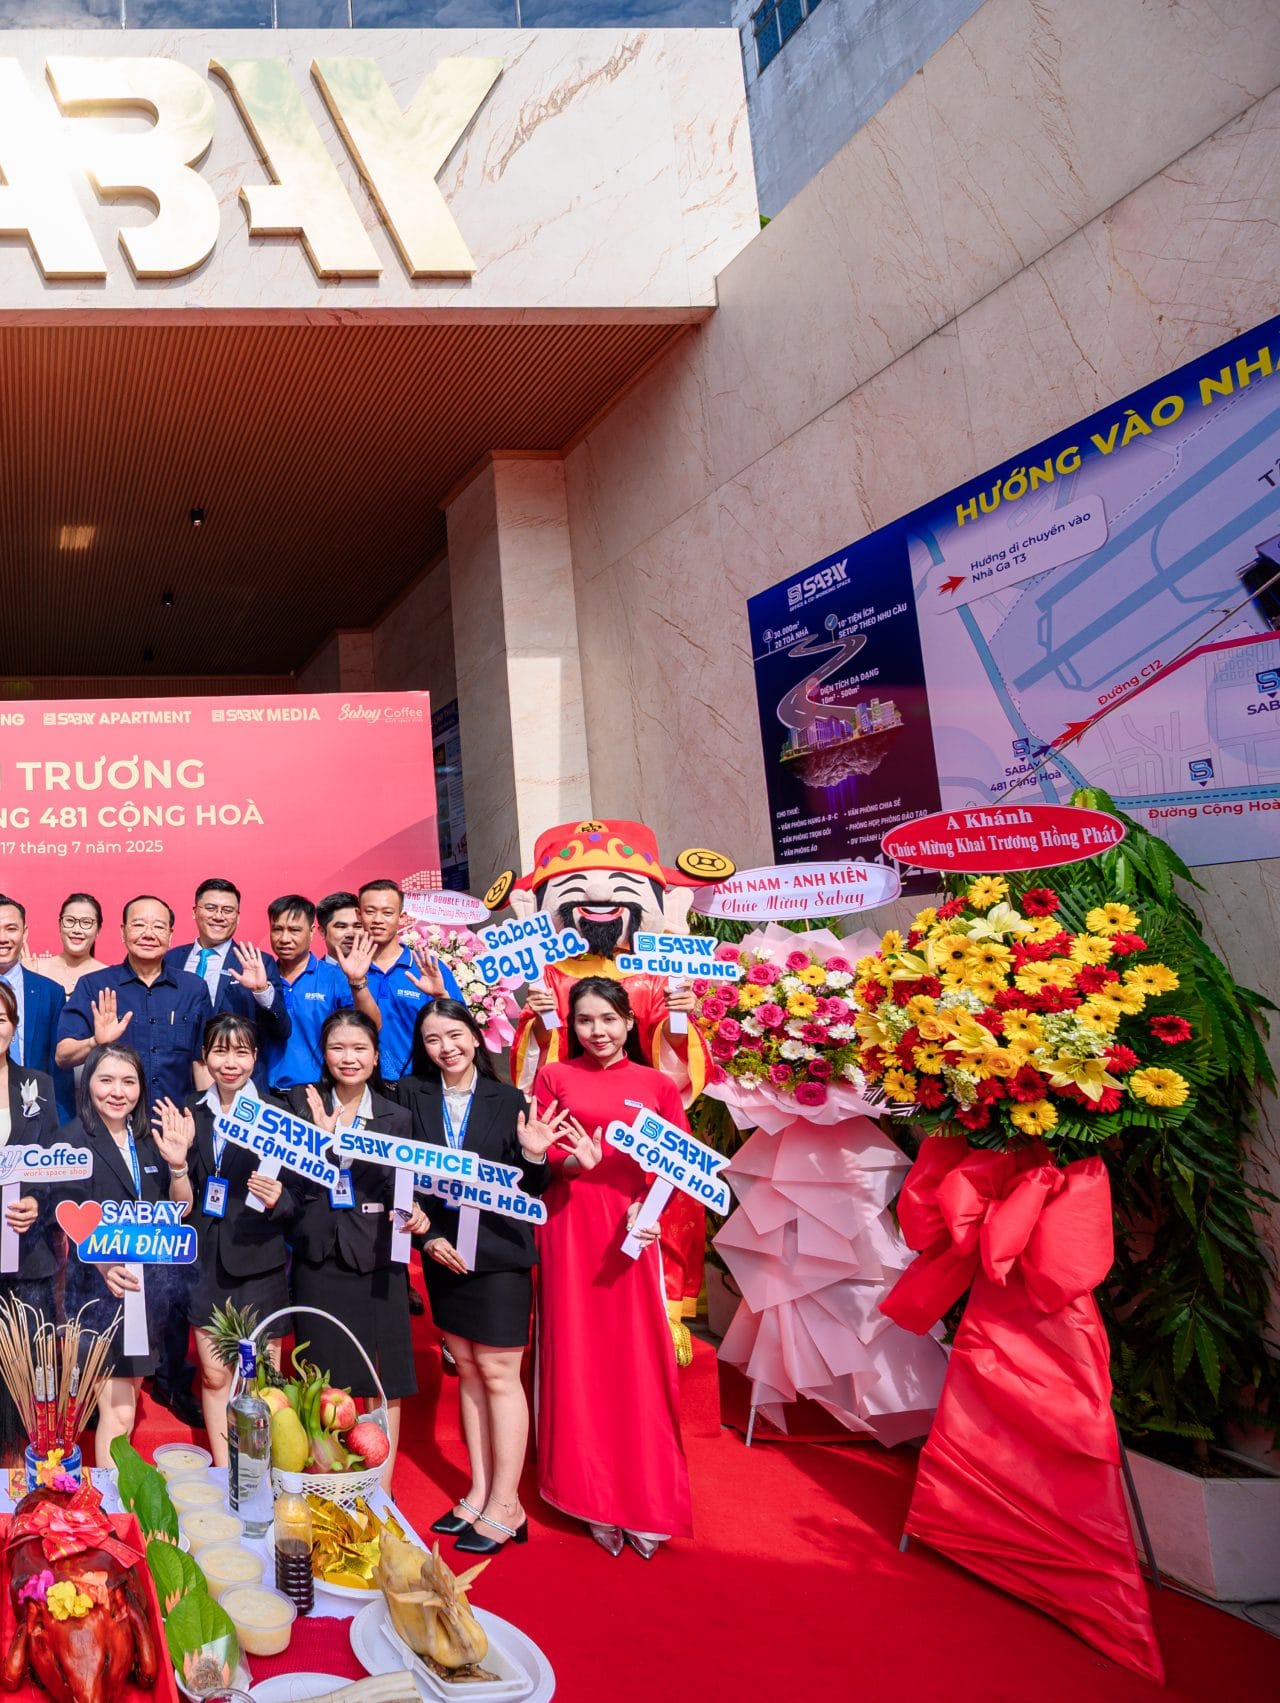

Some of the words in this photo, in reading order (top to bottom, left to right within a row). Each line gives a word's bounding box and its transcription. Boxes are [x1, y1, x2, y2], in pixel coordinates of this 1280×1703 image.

[955, 446, 1082, 528] HƯỚNG
[1090, 395, 1185, 456] VÀO
[1198, 346, 1280, 407] NH
[970, 550, 1006, 571] Hướng
[1022, 524, 1065, 547] chuyển
[1068, 513, 1091, 527] vào
[803, 558, 849, 598] SABAY
[972, 568, 993, 583] Nhà
[996, 561, 1010, 572] Ga
[1013, 553, 1026, 564] T3
[838, 624, 858, 639] SETUP
[859, 618, 876, 631] THEO
[877, 610, 892, 623] NHU
[893, 603, 908, 616] CẦU
[863, 606, 875, 618] ÍCH
[835, 678, 849, 690] TÍCH
[860, 668, 879, 681] DẠNG
[1097, 673, 1140, 706] Đường
[1140, 659, 1163, 679] C12
[57, 712, 96, 725] SABAY
[99, 710, 191, 725] APARTMENT
[226, 708, 265, 722] SABAY
[267, 707, 320, 722] MEDIA
[338, 703, 381, 724] Sabay
[384, 707, 423, 718] Coffee
[16, 754, 206, 791] TRƯƠNG
[990, 782, 1007, 792] 481
[1010, 776, 1037, 789] Cộng
[1040, 770, 1061, 781] Hoà
[39, 806, 87, 829] 481
[98, 801, 186, 833] CỘNG
[196, 798, 265, 826] HOÀ
[947, 816, 960, 830] A
[966, 809, 1034, 828] Khánh
[1148, 807, 1197, 819] Đường
[1202, 804, 1243, 817] Cộng
[1249, 799, 1280, 812] Hoà
[1, 842, 16, 855] 17
[19, 841, 67, 857] tháng
[72, 842, 81, 854] 7
[85, 839, 121, 854] năm
[126, 839, 163, 853] 2025
[888, 842, 917, 860] Chúc
[920, 840, 955, 857] Mừng
[957, 836, 986, 853] Khai
[987, 834, 1038, 852] Trương
[1040, 825, 1079, 849] Hồng
[1081, 825, 1117, 844] Phát
[712, 881, 743, 895] ANH
[747, 878, 781, 892] NAM
[793, 874, 826, 889] ANH
[830, 867, 868, 884] KIÊN
[462, 899, 480, 908] LAND
[721, 898, 758, 913] Chúc
[763, 896, 808, 911] Mừng
[814, 890, 864, 909] Sabay
[484, 912, 551, 950] Sabay
[479, 947, 539, 983] Bay
[543, 931, 586, 962] Xa
[658, 937, 718, 956] SABAY
[620, 958, 646, 971] 09
[648, 954, 685, 973] CỬU
[688, 958, 738, 977] LONG
[257, 1107, 333, 1158] SABAY
[23, 1149, 88, 1167] Coffee
[218, 1118, 250, 1143] 481
[252, 1135, 297, 1167] CỘNG
[300, 1156, 336, 1185] HÒA
[339, 1133, 395, 1160] SABAY
[395, 1144, 473, 1176] OFFICE
[659, 1130, 721, 1177] SABAY
[23, 1168, 44, 1177] work
[46, 1170, 68, 1178] space
[70, 1167, 88, 1177] shop
[478, 1163, 518, 1188] ABAY
[612, 1128, 635, 1148] 99
[636, 1145, 686, 1186] CỘNG
[688, 1170, 726, 1208] HOÀ
[438, 1179, 492, 1205] CỘNG
[498, 1195, 542, 1219] HÒA
[103, 1203, 184, 1224] SABAY
[87, 1229, 130, 1255] MÃI
[136, 1229, 191, 1257] ĐỈNH
